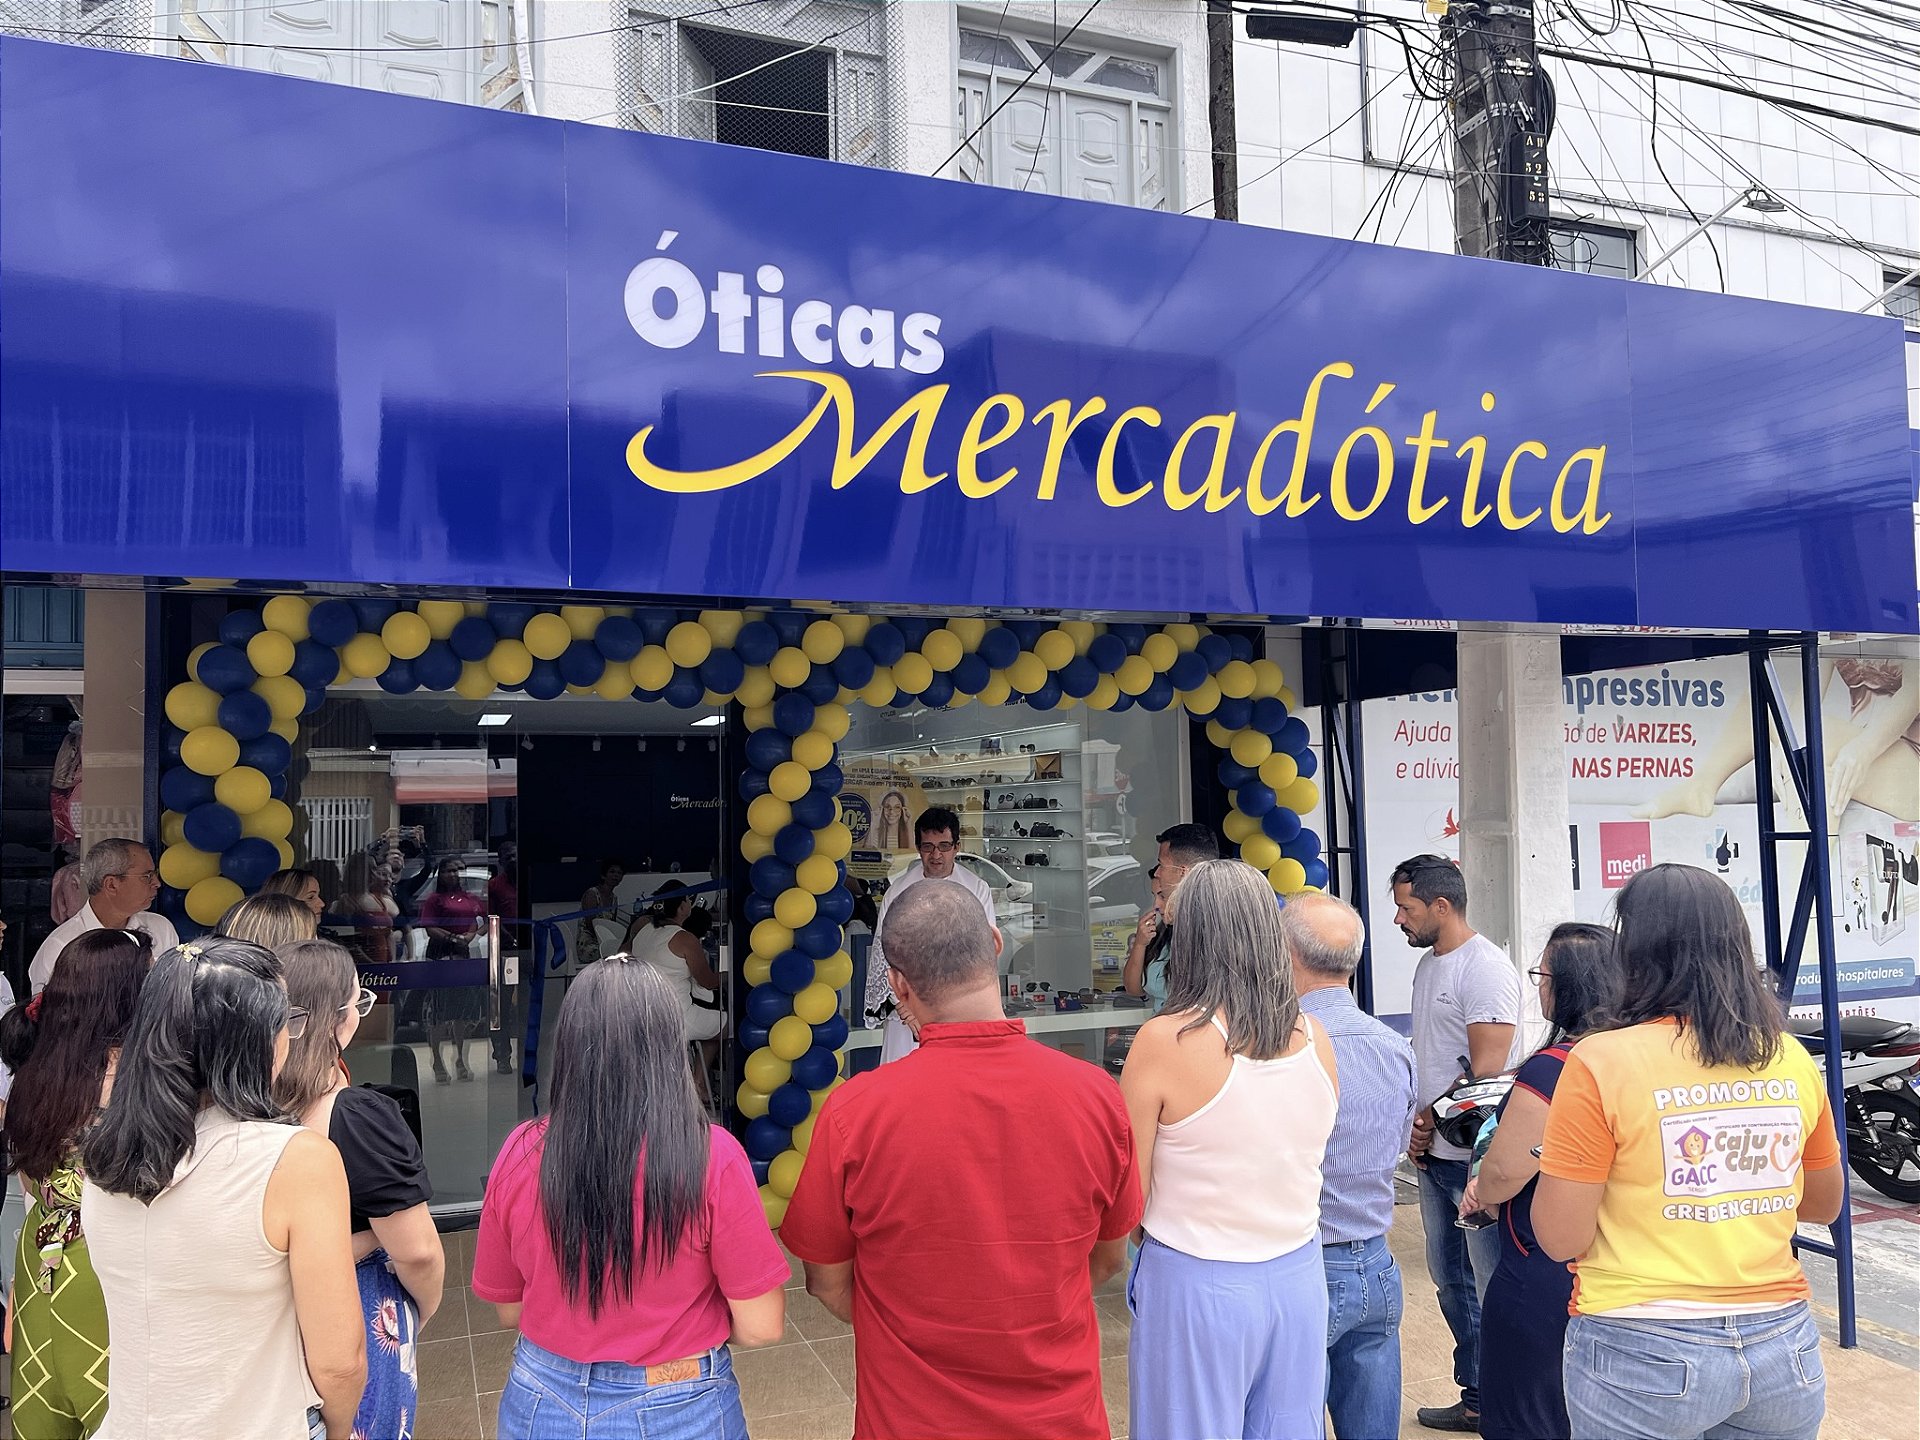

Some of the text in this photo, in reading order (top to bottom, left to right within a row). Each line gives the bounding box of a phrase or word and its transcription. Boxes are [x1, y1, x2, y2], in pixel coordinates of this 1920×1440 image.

[623, 229, 945, 374] Óticas
[625, 361, 1612, 536] Mercadótica
[1394, 719, 1452, 746] Ajuda
[1586, 723, 1607, 742] de
[1612, 722, 1697, 746] VARIZES,
[1395, 763, 1407, 779] e
[1572, 757, 1694, 779] NAS PERNAS
[843, 807, 867, 830] 0%
[1607, 854, 1646, 874] medi
[1839, 1006, 1877, 1019] ARTÕES
[1653, 1079, 1799, 1110] PROMOTOR
[1714, 1129, 1768, 1157] Caju
[1671, 1164, 1718, 1187] GACC
[1725, 1151, 1769, 1176] Cap
[1662, 1193, 1797, 1224] CREDENCIADO
